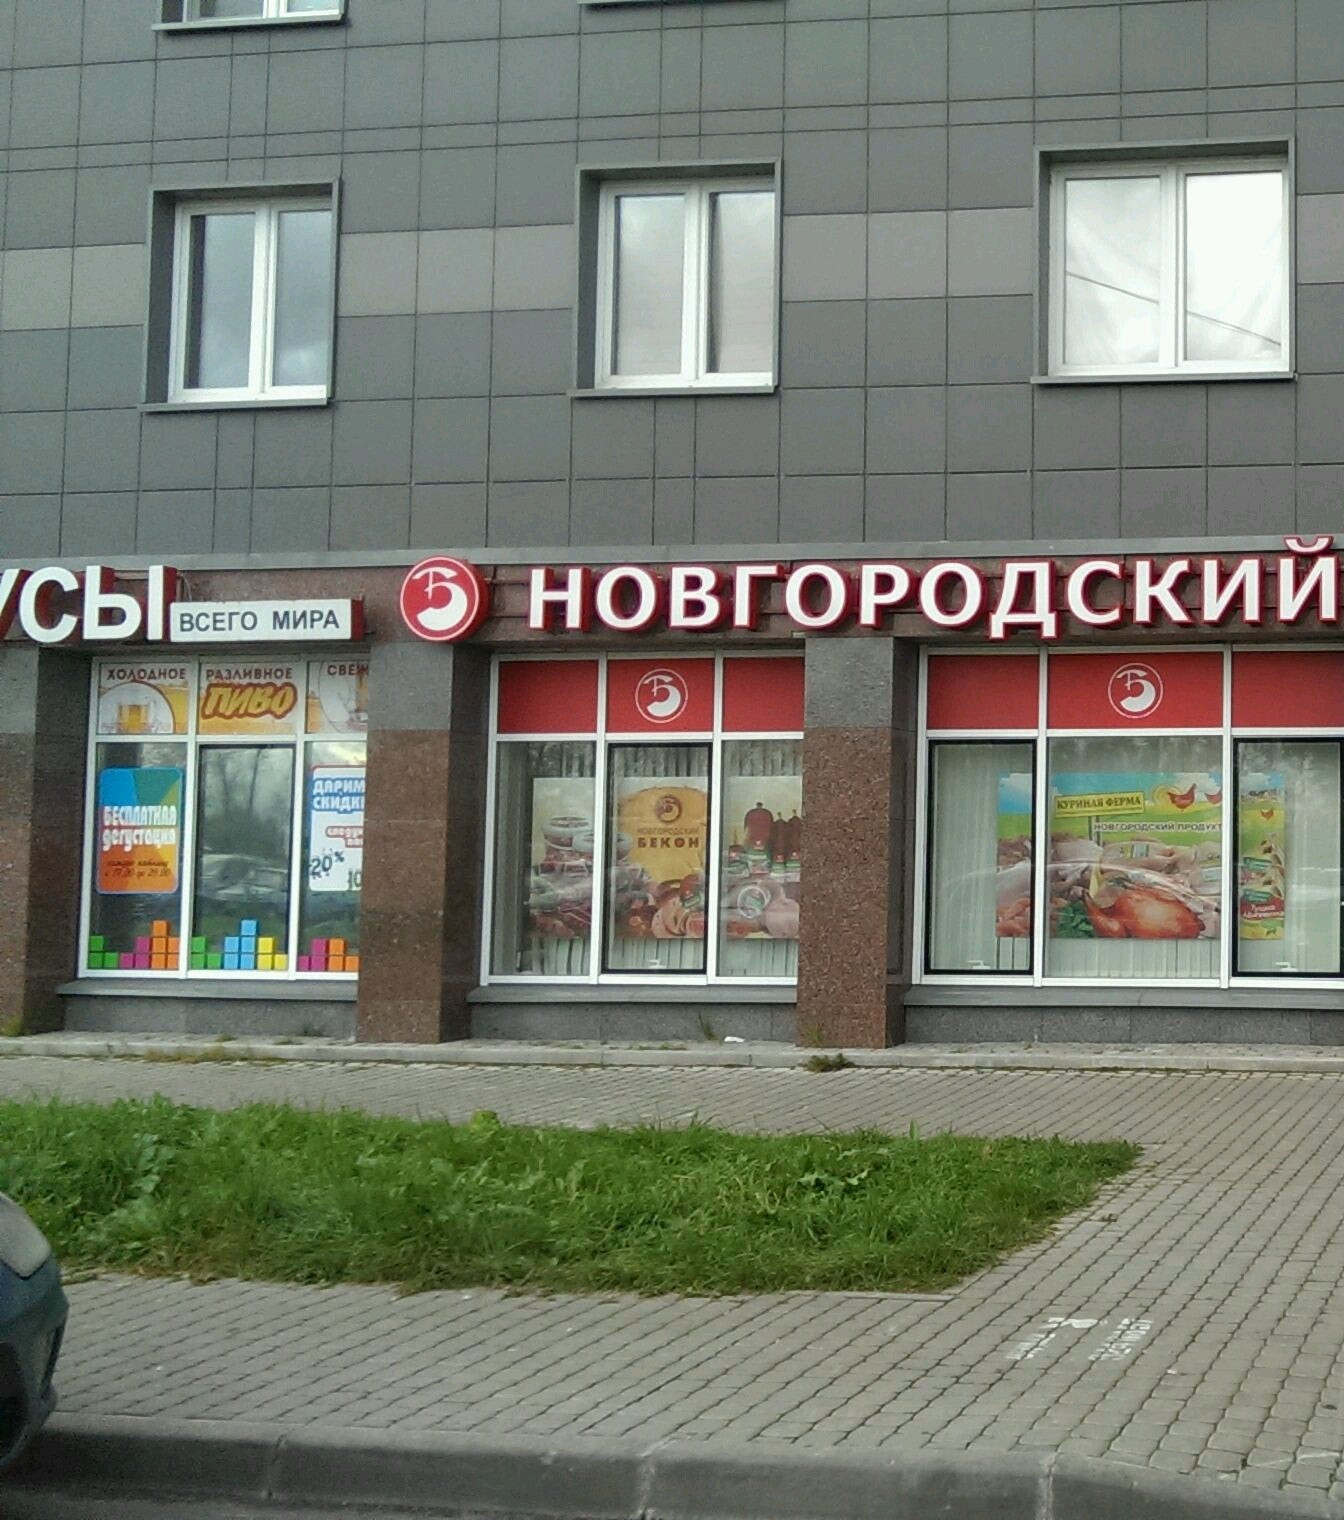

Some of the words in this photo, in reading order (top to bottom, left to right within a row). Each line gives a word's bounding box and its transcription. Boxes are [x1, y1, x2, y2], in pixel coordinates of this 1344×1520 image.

[529, 537, 1337, 639] НОВГОРОДСКИЙ
[180, 610, 257, 632] ВСЕГО
[272, 609, 339, 630] МИРА
[107, 667, 186, 681] ХОЛОДНОЕ
[206, 667, 293, 681] РАЗЛИВНОЕ
[204, 683, 297, 718] ПИВО
[1057, 798, 1104, 809] КУРИНАЯ
[1106, 796, 1141, 806] ФЕРМА
[103, 805, 177, 826] БЕСПЛАТНАЯ
[1093, 822, 1175, 832] НОВГОРОДСКИЙ
[637, 837, 700, 849] БЕКОН
